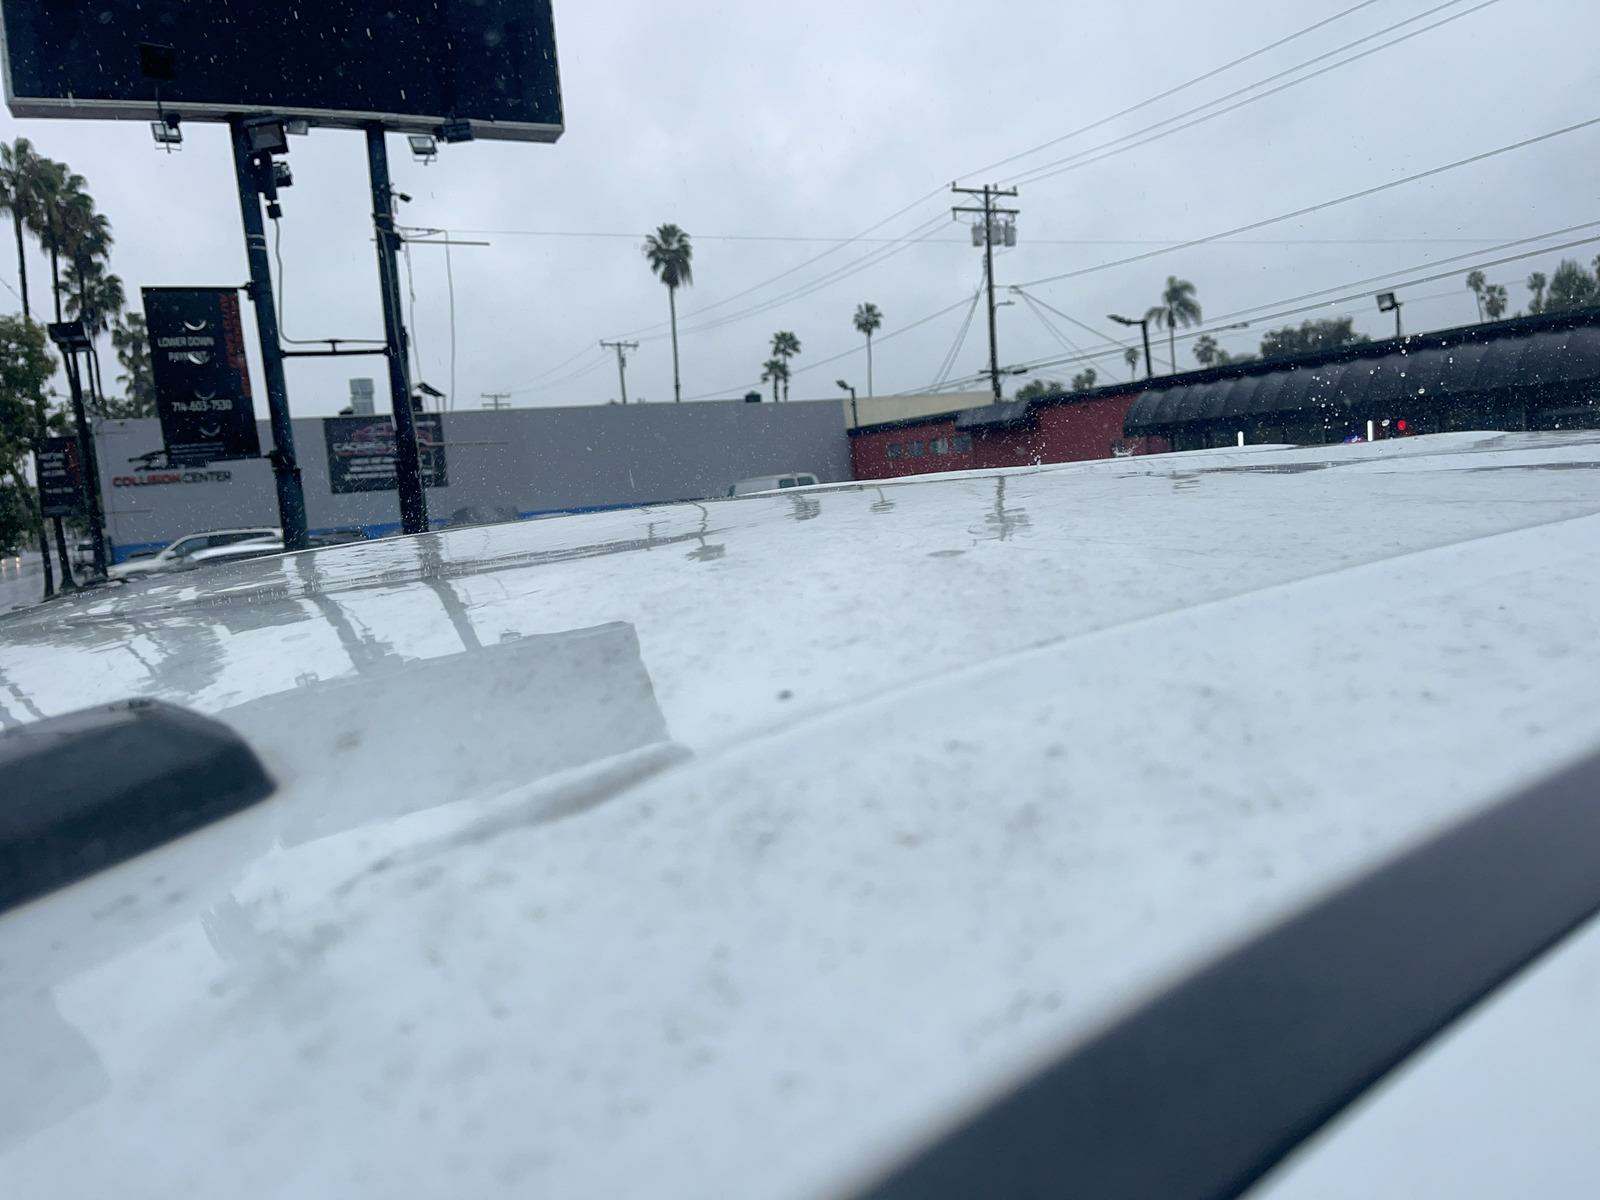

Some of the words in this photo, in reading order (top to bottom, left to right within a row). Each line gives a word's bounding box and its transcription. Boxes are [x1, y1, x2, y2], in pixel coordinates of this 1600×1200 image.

[158, 337, 186, 347] LOWER
[187, 337, 214, 346] DOWN
[112, 473, 181, 487] COLLISION
[182, 471, 231, 483] CENTER
